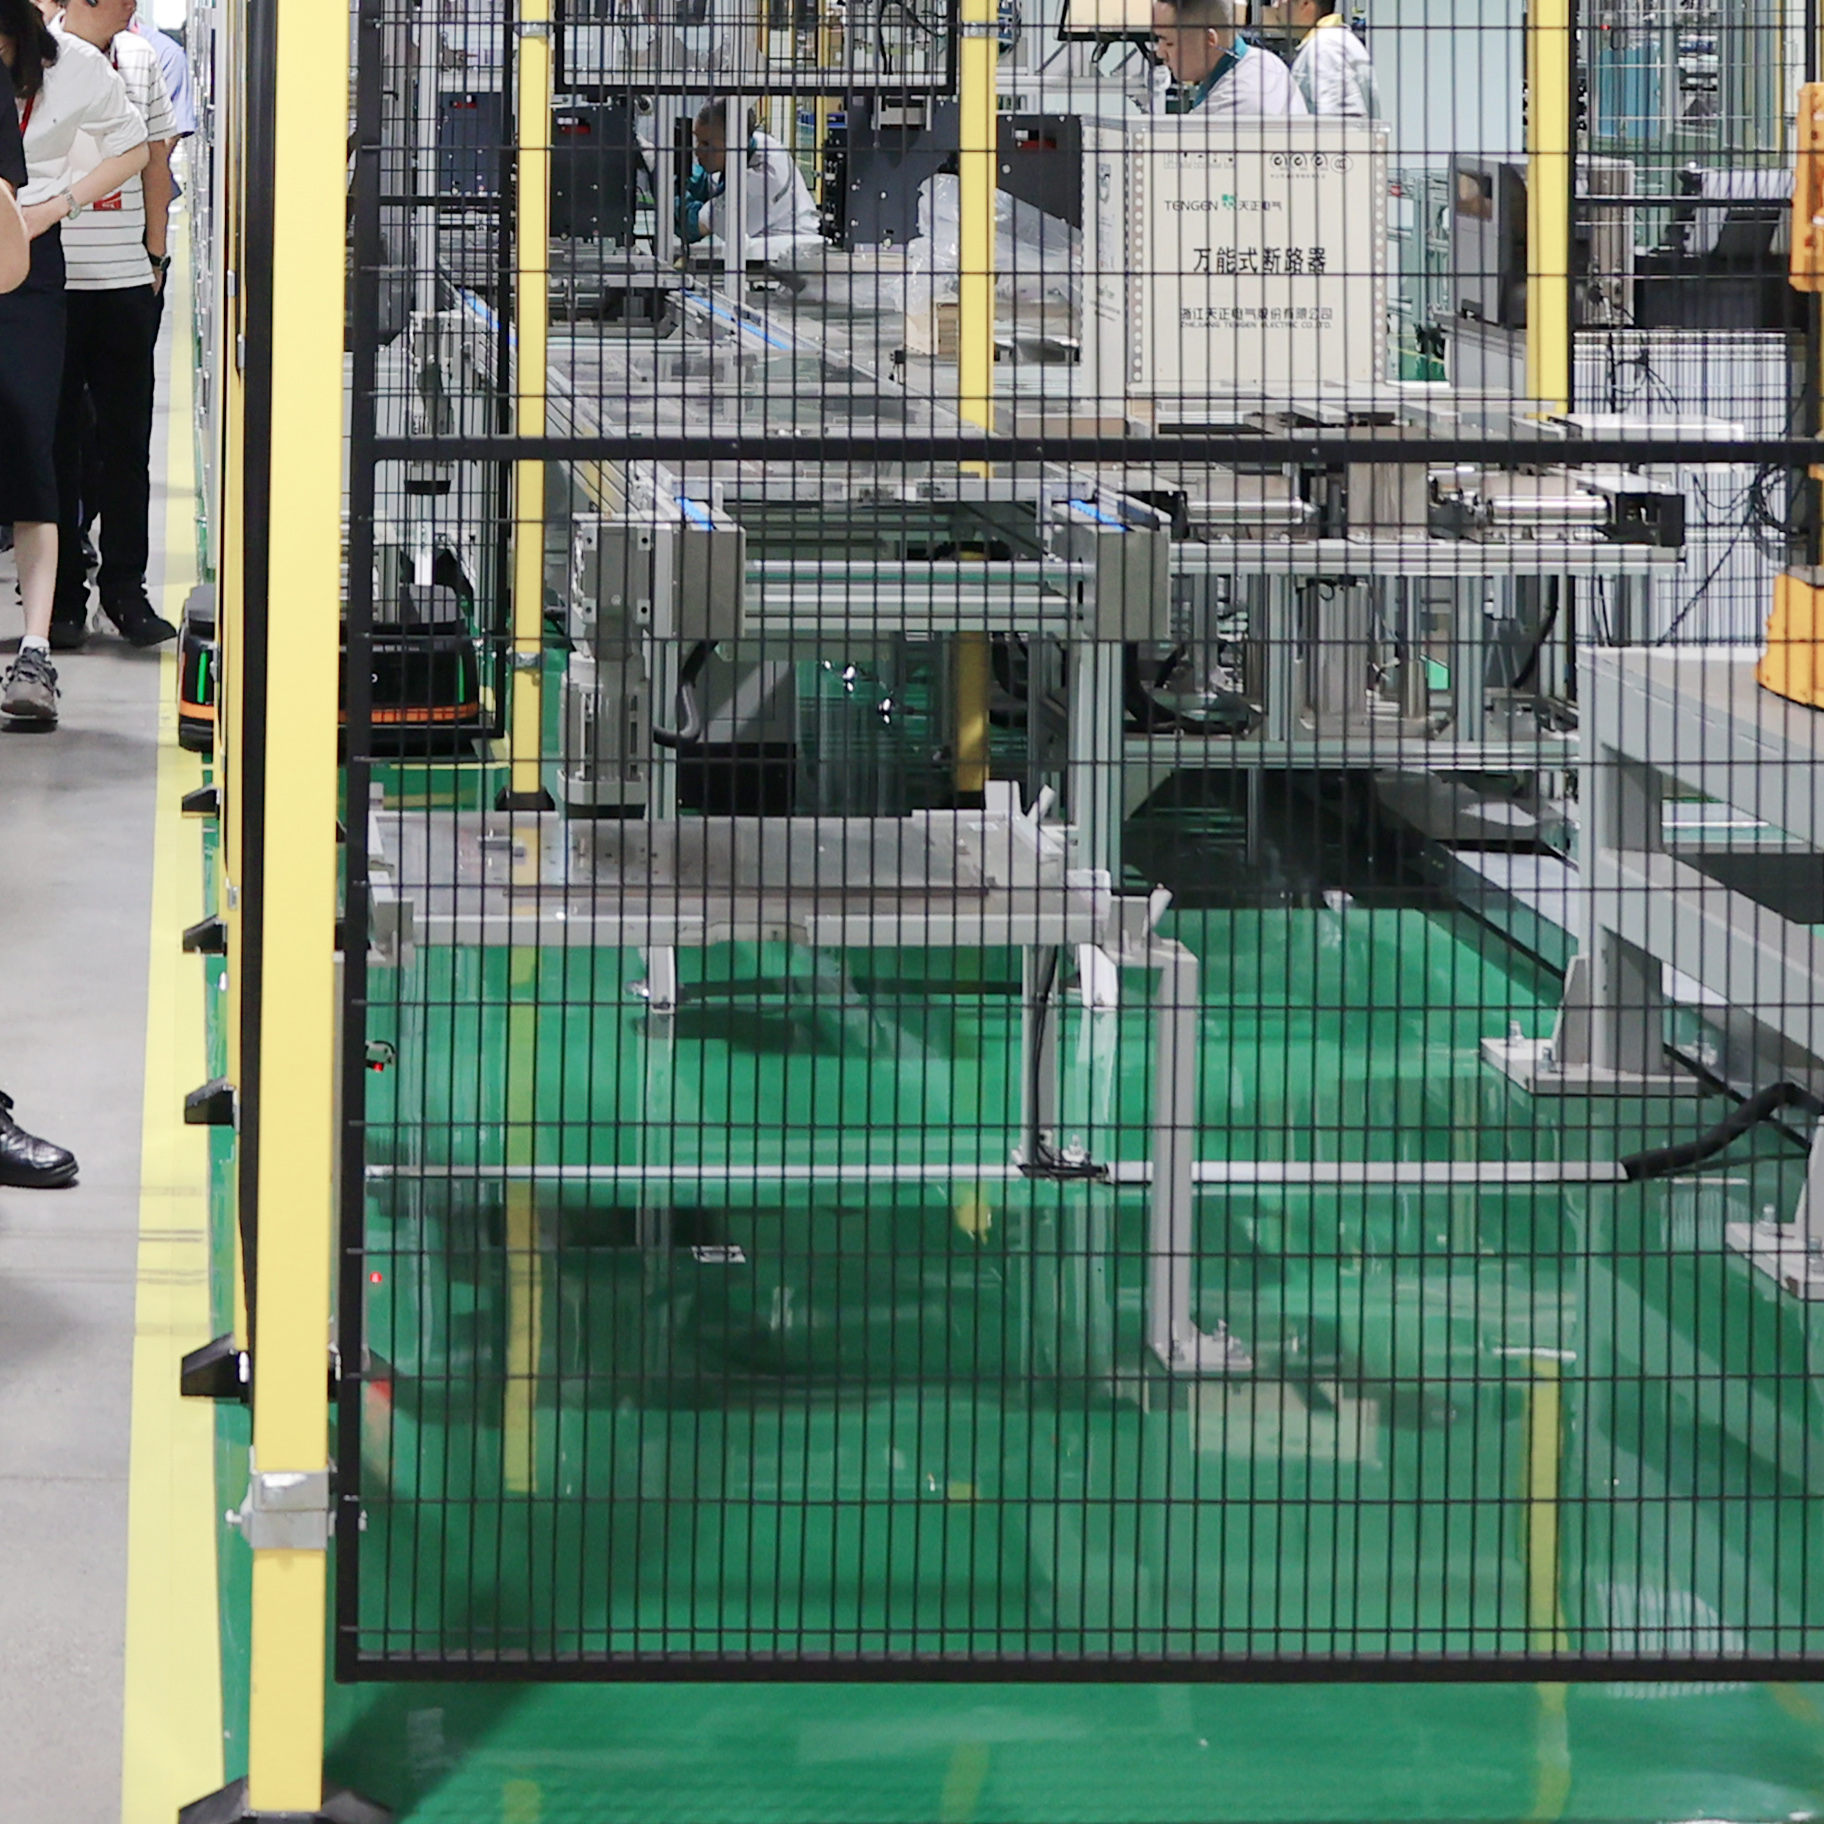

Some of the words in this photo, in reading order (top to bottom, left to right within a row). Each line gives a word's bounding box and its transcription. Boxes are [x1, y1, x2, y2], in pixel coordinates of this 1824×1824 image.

[1165, 200, 1218, 211] TENGEN
[1238, 200, 1282, 212] 天正电气
[1193, 247, 1327, 274] 万能式断路器
